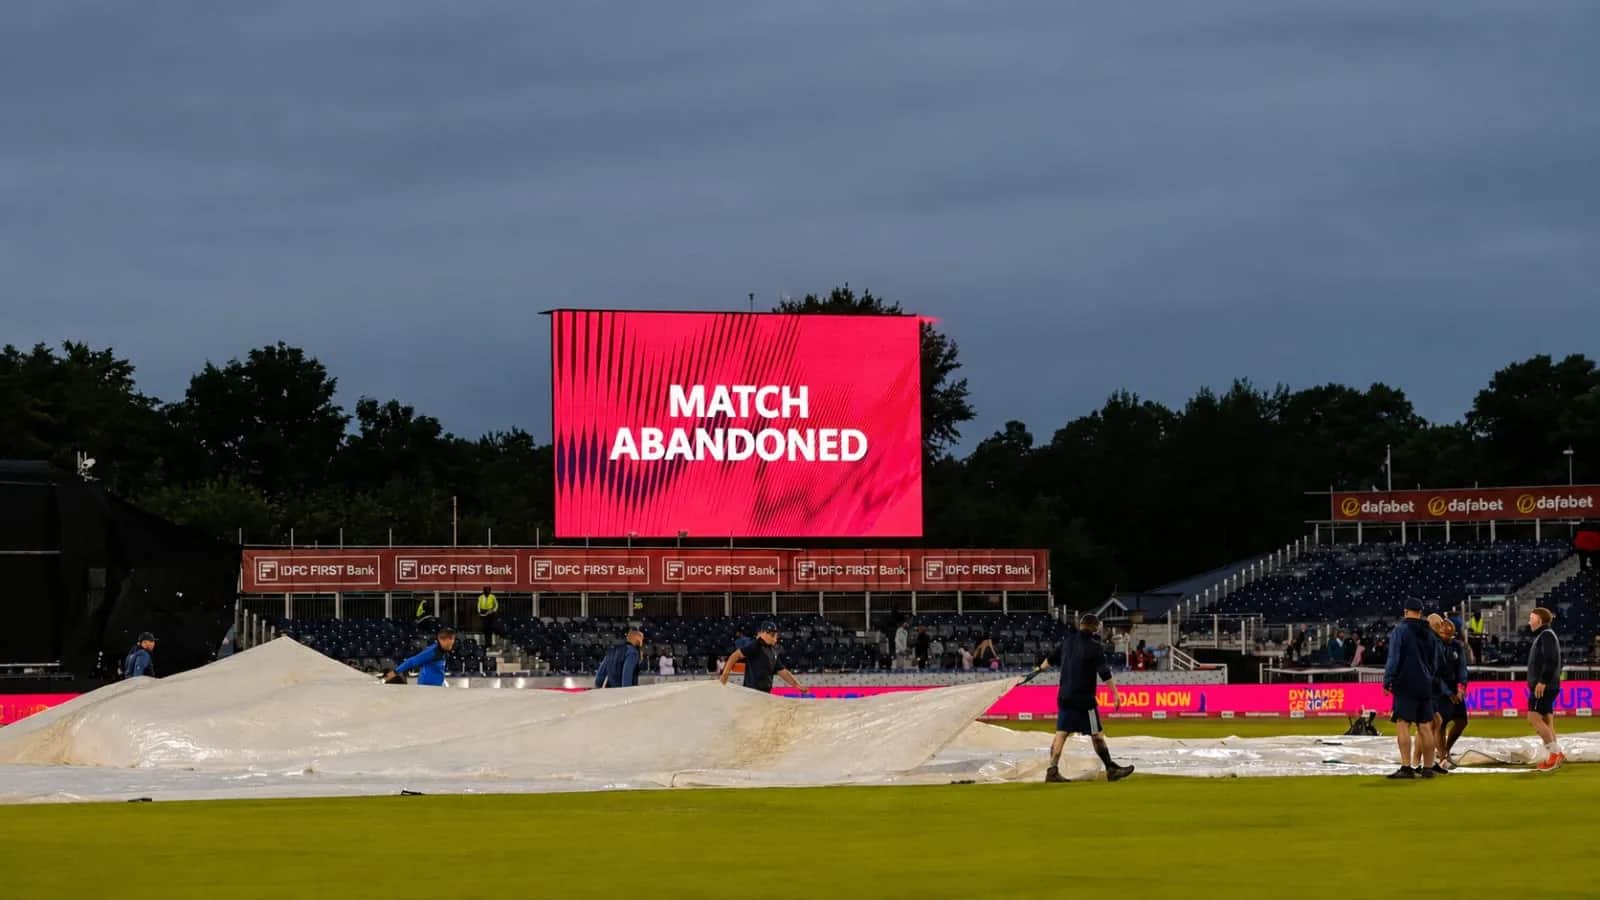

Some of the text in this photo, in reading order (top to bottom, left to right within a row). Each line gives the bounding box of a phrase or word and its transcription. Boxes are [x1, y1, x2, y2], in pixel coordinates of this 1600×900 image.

[669, 384, 809, 418] MATCH
[609, 427, 868, 462] ABANDONED
[1361, 500, 1415, 515] dafabet
[1448, 498, 1503, 515] dafabet
[1536, 494, 1593, 511] dafabet
[280, 563, 374, 576] IDFC FIRST Bank
[420, 563, 512, 576] IDFC FIRST Bank
[554, 563, 645, 576] IDFC FIRST Bank
[687, 564, 775, 576] IDFC FIRST Bank
[818, 564, 906, 576] IDFC FIRST Bank
[945, 563, 1031, 575] IDFC FIRST Bank
[1155, 691, 1191, 706] NOW
